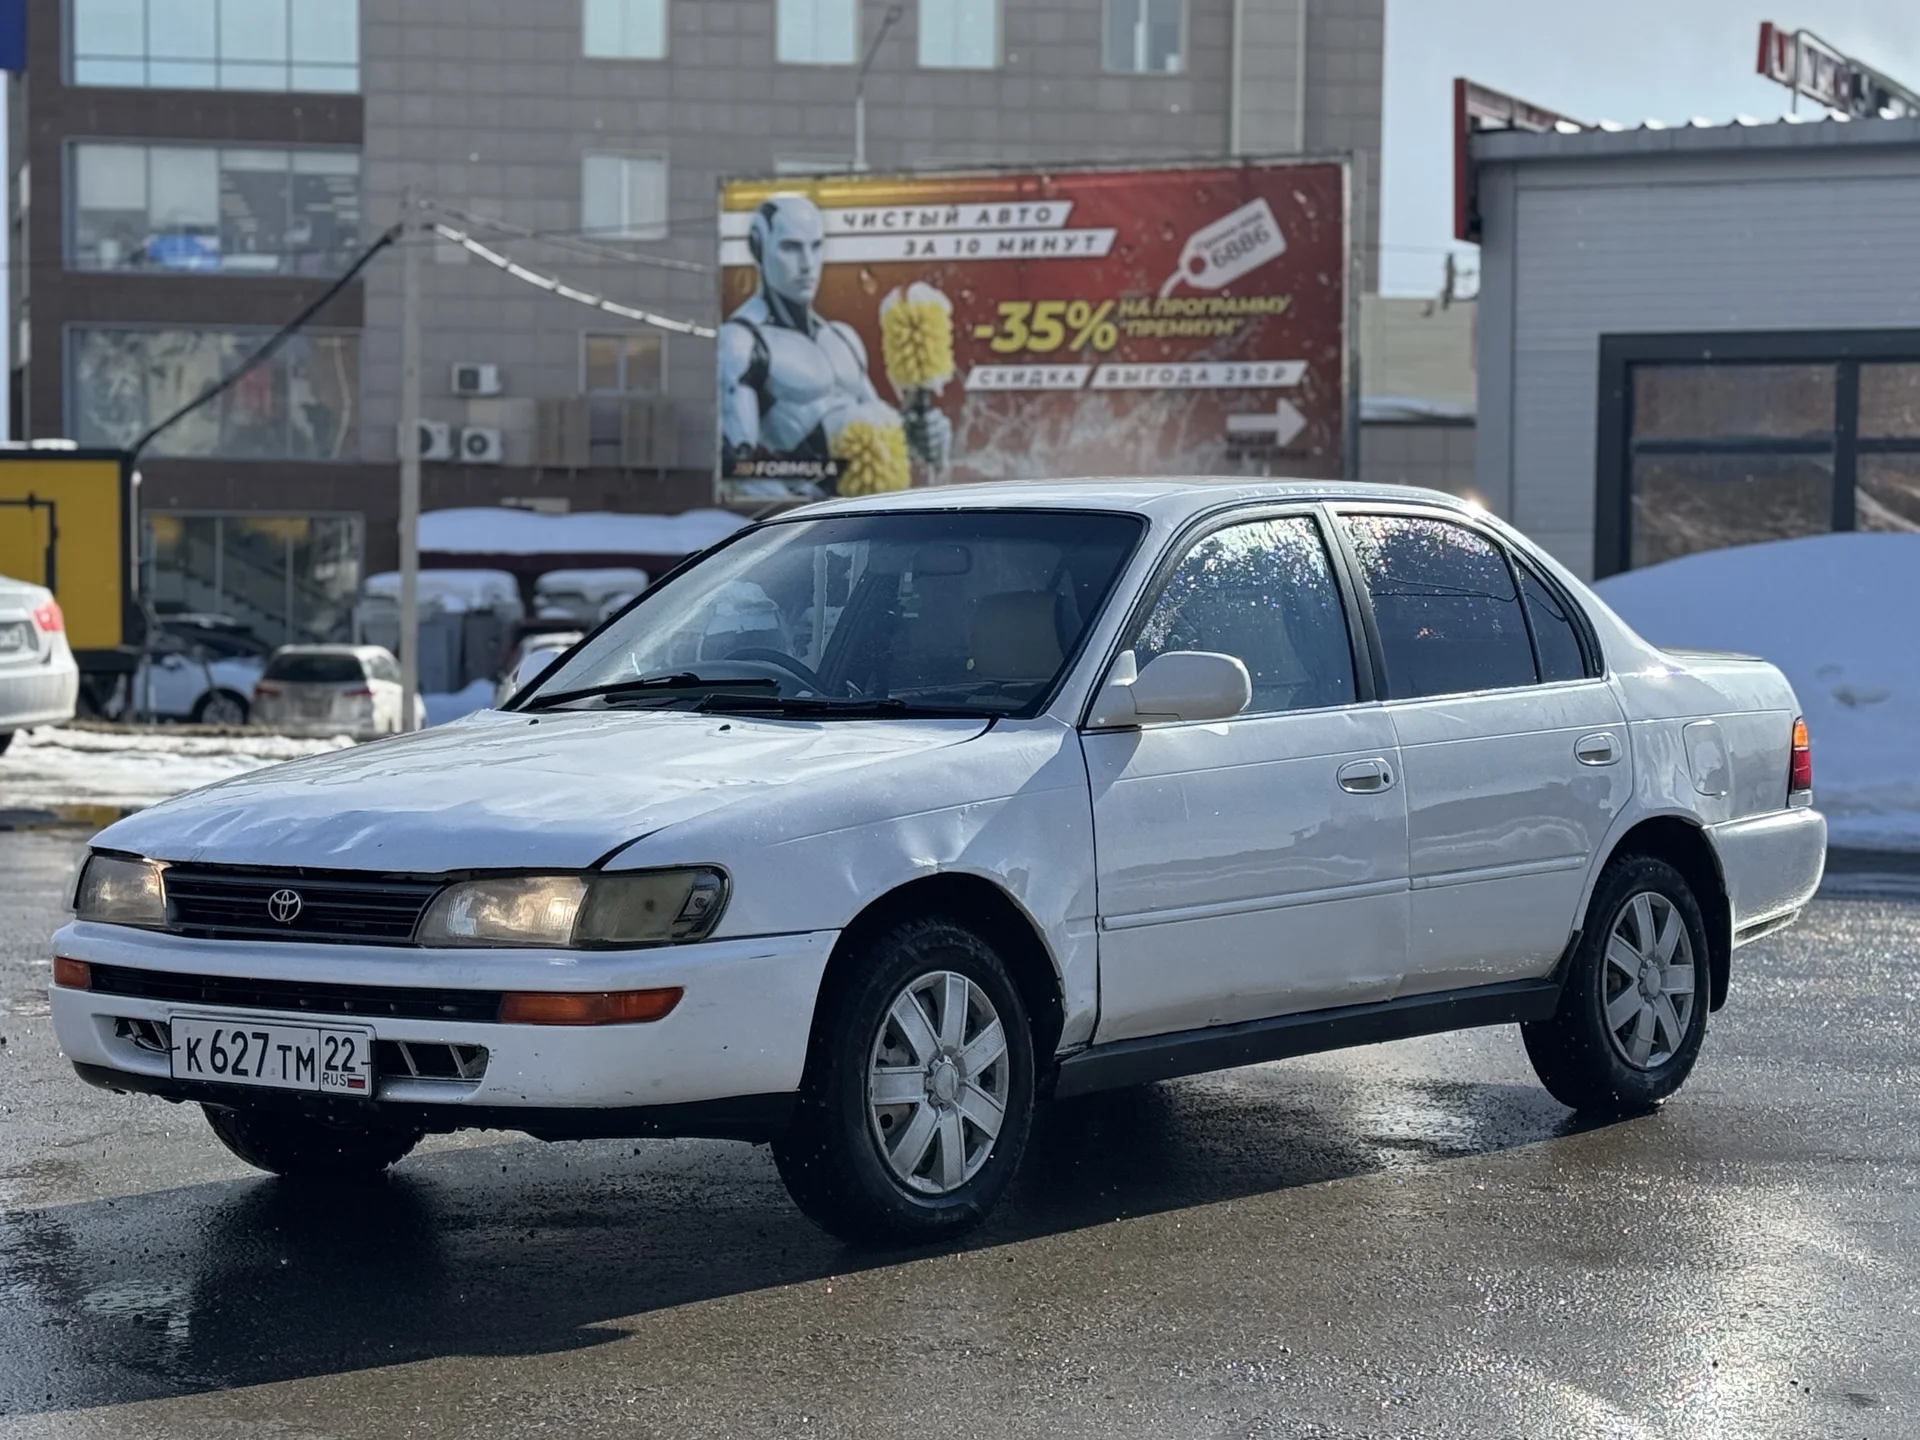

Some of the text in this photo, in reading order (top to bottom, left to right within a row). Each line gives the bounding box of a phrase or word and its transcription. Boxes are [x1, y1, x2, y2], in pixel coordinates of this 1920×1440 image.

[843, 205, 1053, 228] ЧИСТЫЙ АВТО
[903, 234, 1098, 256] ЗА 10 МИНУТ
[1118, 296, 1293, 317] НА ПРОГРАММУ
[973, 300, 1119, 353] -35%
[978, 370, 1077, 387] СКИДКА
[1104, 367, 1210, 385] ВЫГОДА
[324, 1035, 356, 1072] 22
[322, 1071, 347, 1087] RUS
